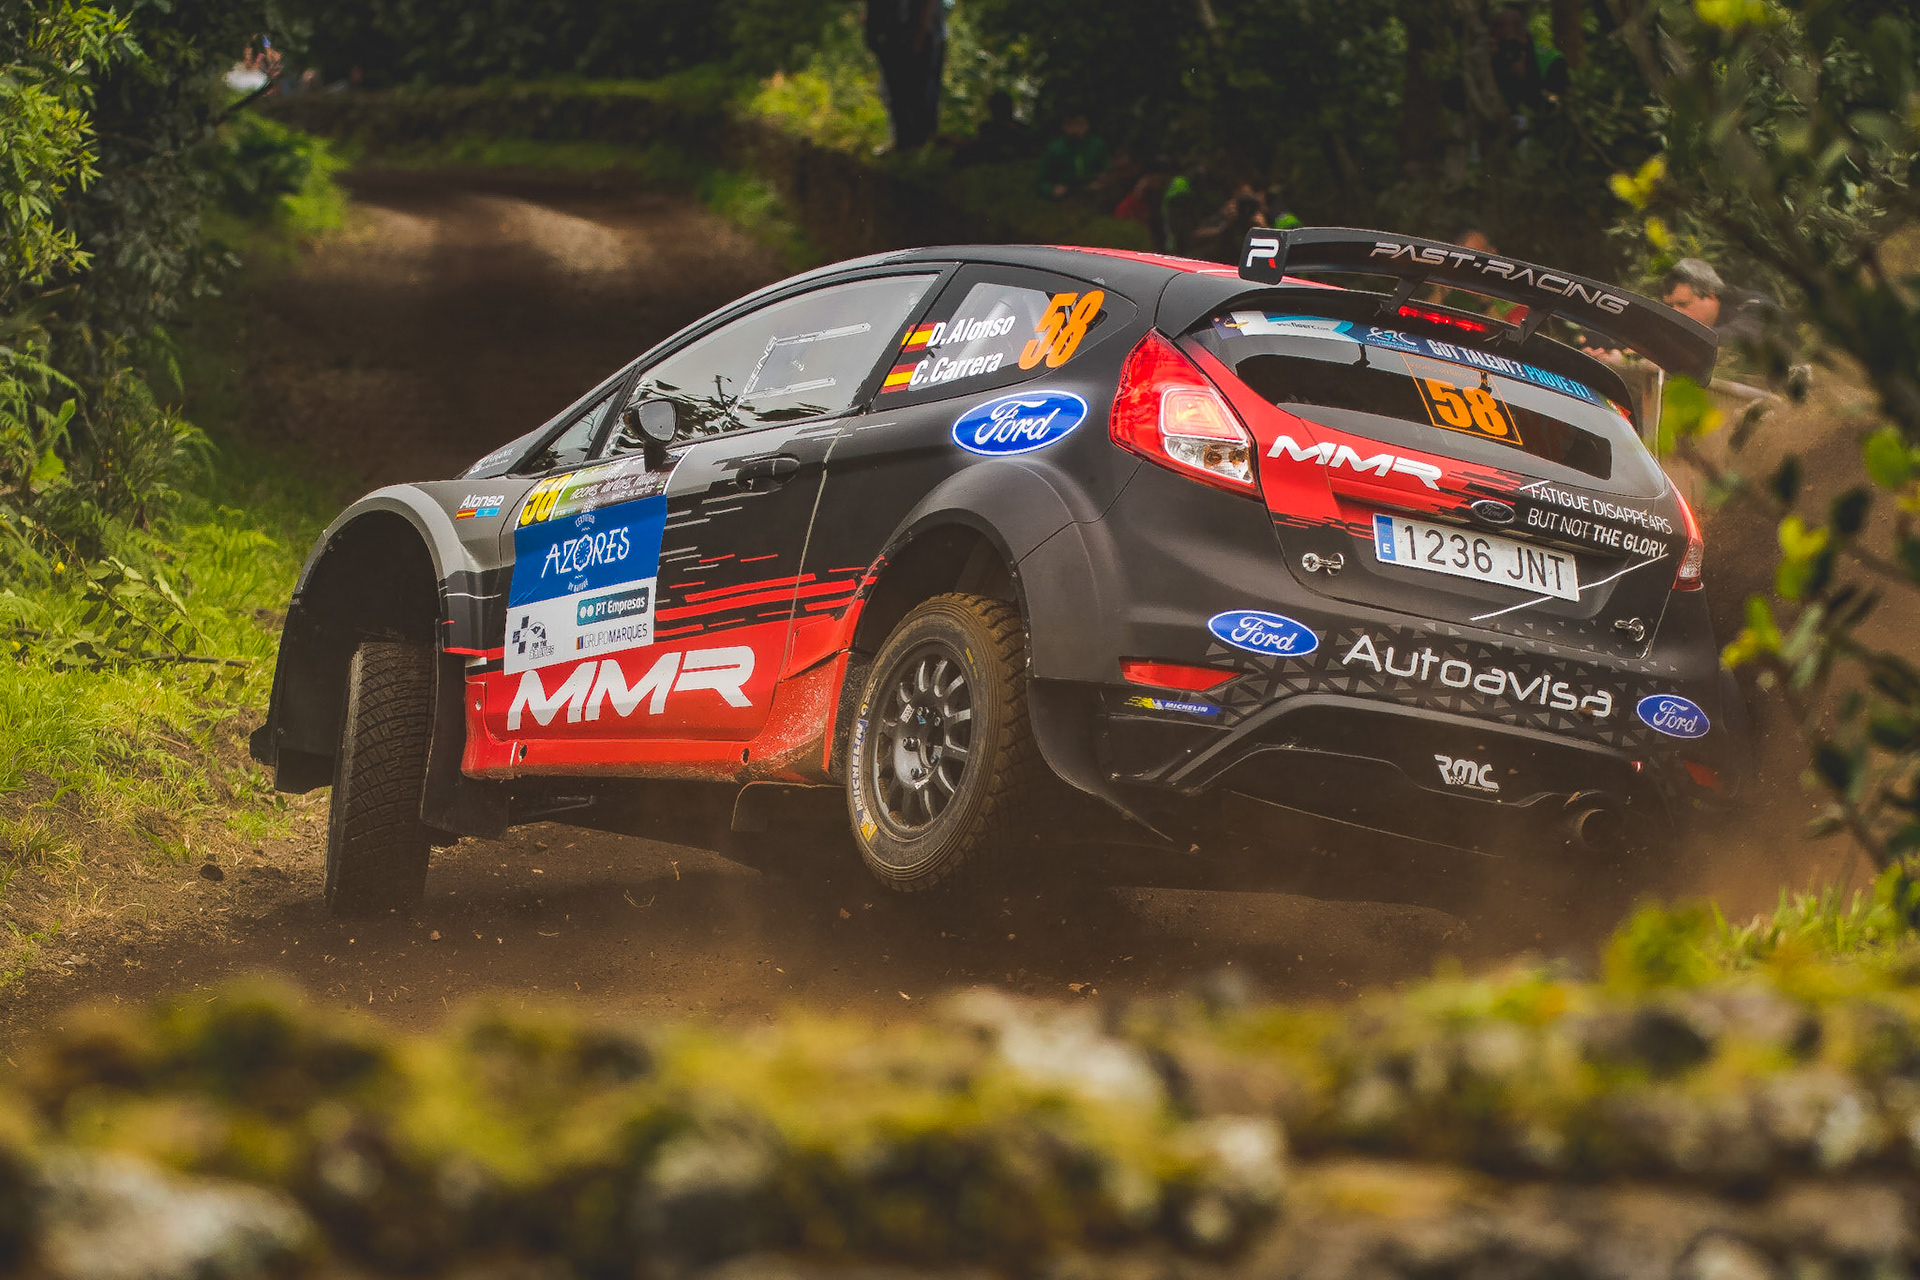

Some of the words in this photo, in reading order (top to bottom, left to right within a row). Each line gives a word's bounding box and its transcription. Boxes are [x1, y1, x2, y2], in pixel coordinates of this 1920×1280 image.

[1018, 290, 1104, 370] 58
[1427, 339, 1461, 360] GOT
[1461, 348, 1526, 377] TALENT?
[1522, 364, 1574, 394] PROVE
[1567, 380, 1594, 401] IT!
[974, 399, 1061, 446] Ford
[1425, 377, 1508, 436] 58
[1266, 435, 1442, 491] MMR
[459, 494, 505, 509] Alonso
[1529, 485, 1591, 514] FATIGUE
[1593, 499, 1673, 535] DISAPPEARS
[541, 526, 630, 578] AZORES
[1404, 525, 1493, 574] 1236
[1507, 546, 1565, 591] JNT
[1528, 508, 1559, 531] BUT
[1560, 518, 1591, 539] NOT
[1593, 524, 1620, 548] THE
[1623, 533, 1669, 558] GLORY
[595, 602, 607, 616] PT
[607, 597, 646, 615] Empresas
[1231, 616, 1298, 651] Ford
[507, 645, 755, 731] MMR
[1342, 634, 1613, 718] Autoavisa
[1165, 702, 1208, 713] MICHELIN
[1652, 700, 1699, 734] Ford
